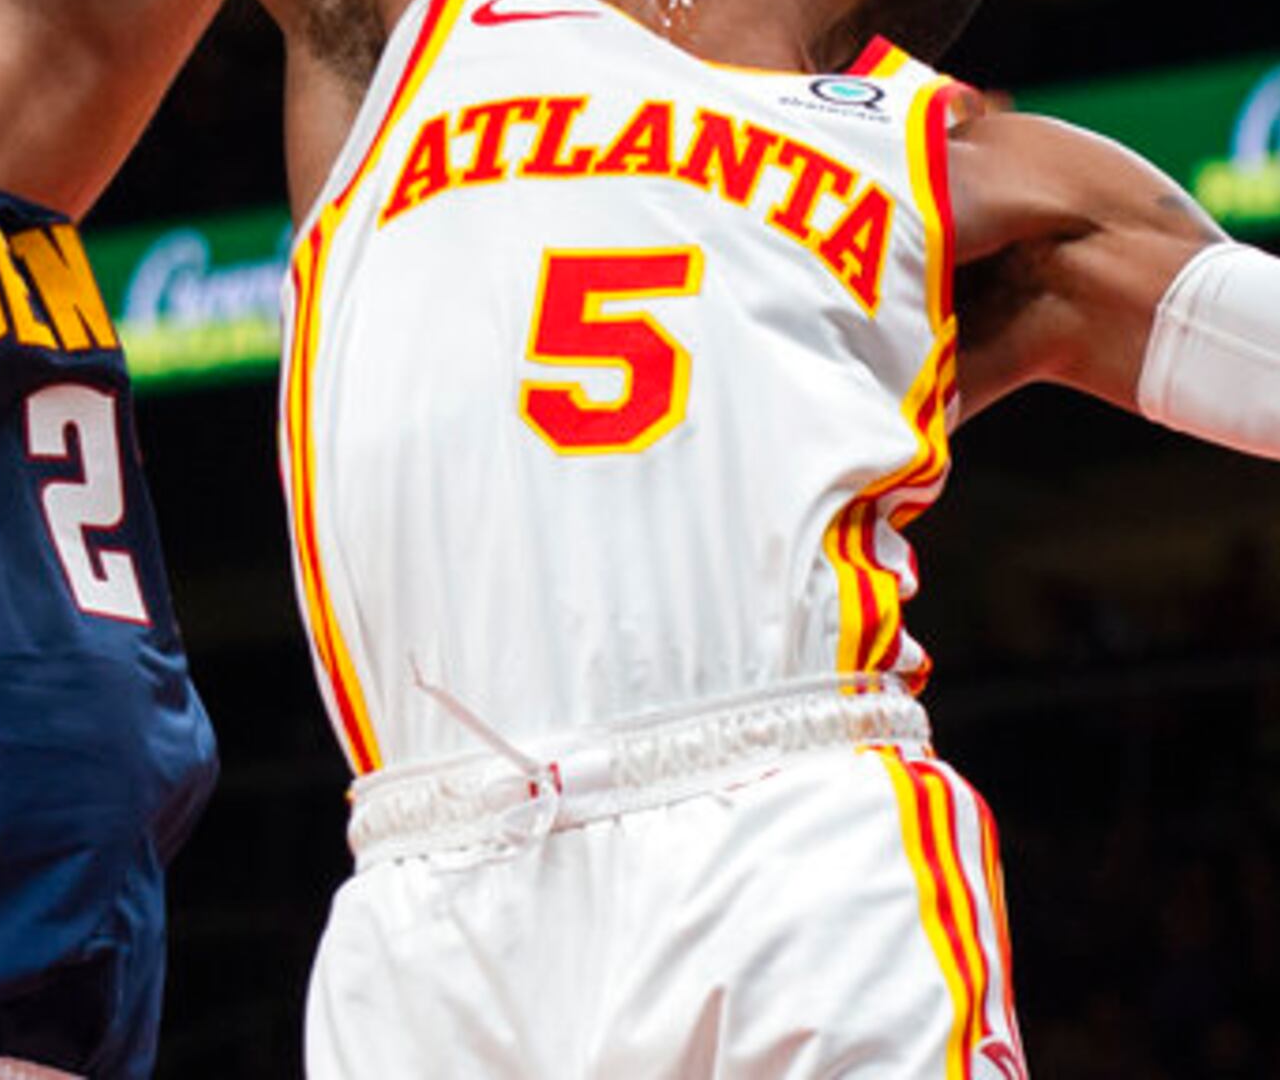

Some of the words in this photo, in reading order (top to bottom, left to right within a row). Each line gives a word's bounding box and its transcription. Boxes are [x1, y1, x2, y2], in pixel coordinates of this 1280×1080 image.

[377, 94, 898, 319] ATLANTA
[518, 243, 704, 457] 5
[24, 382, 153, 626] 2
